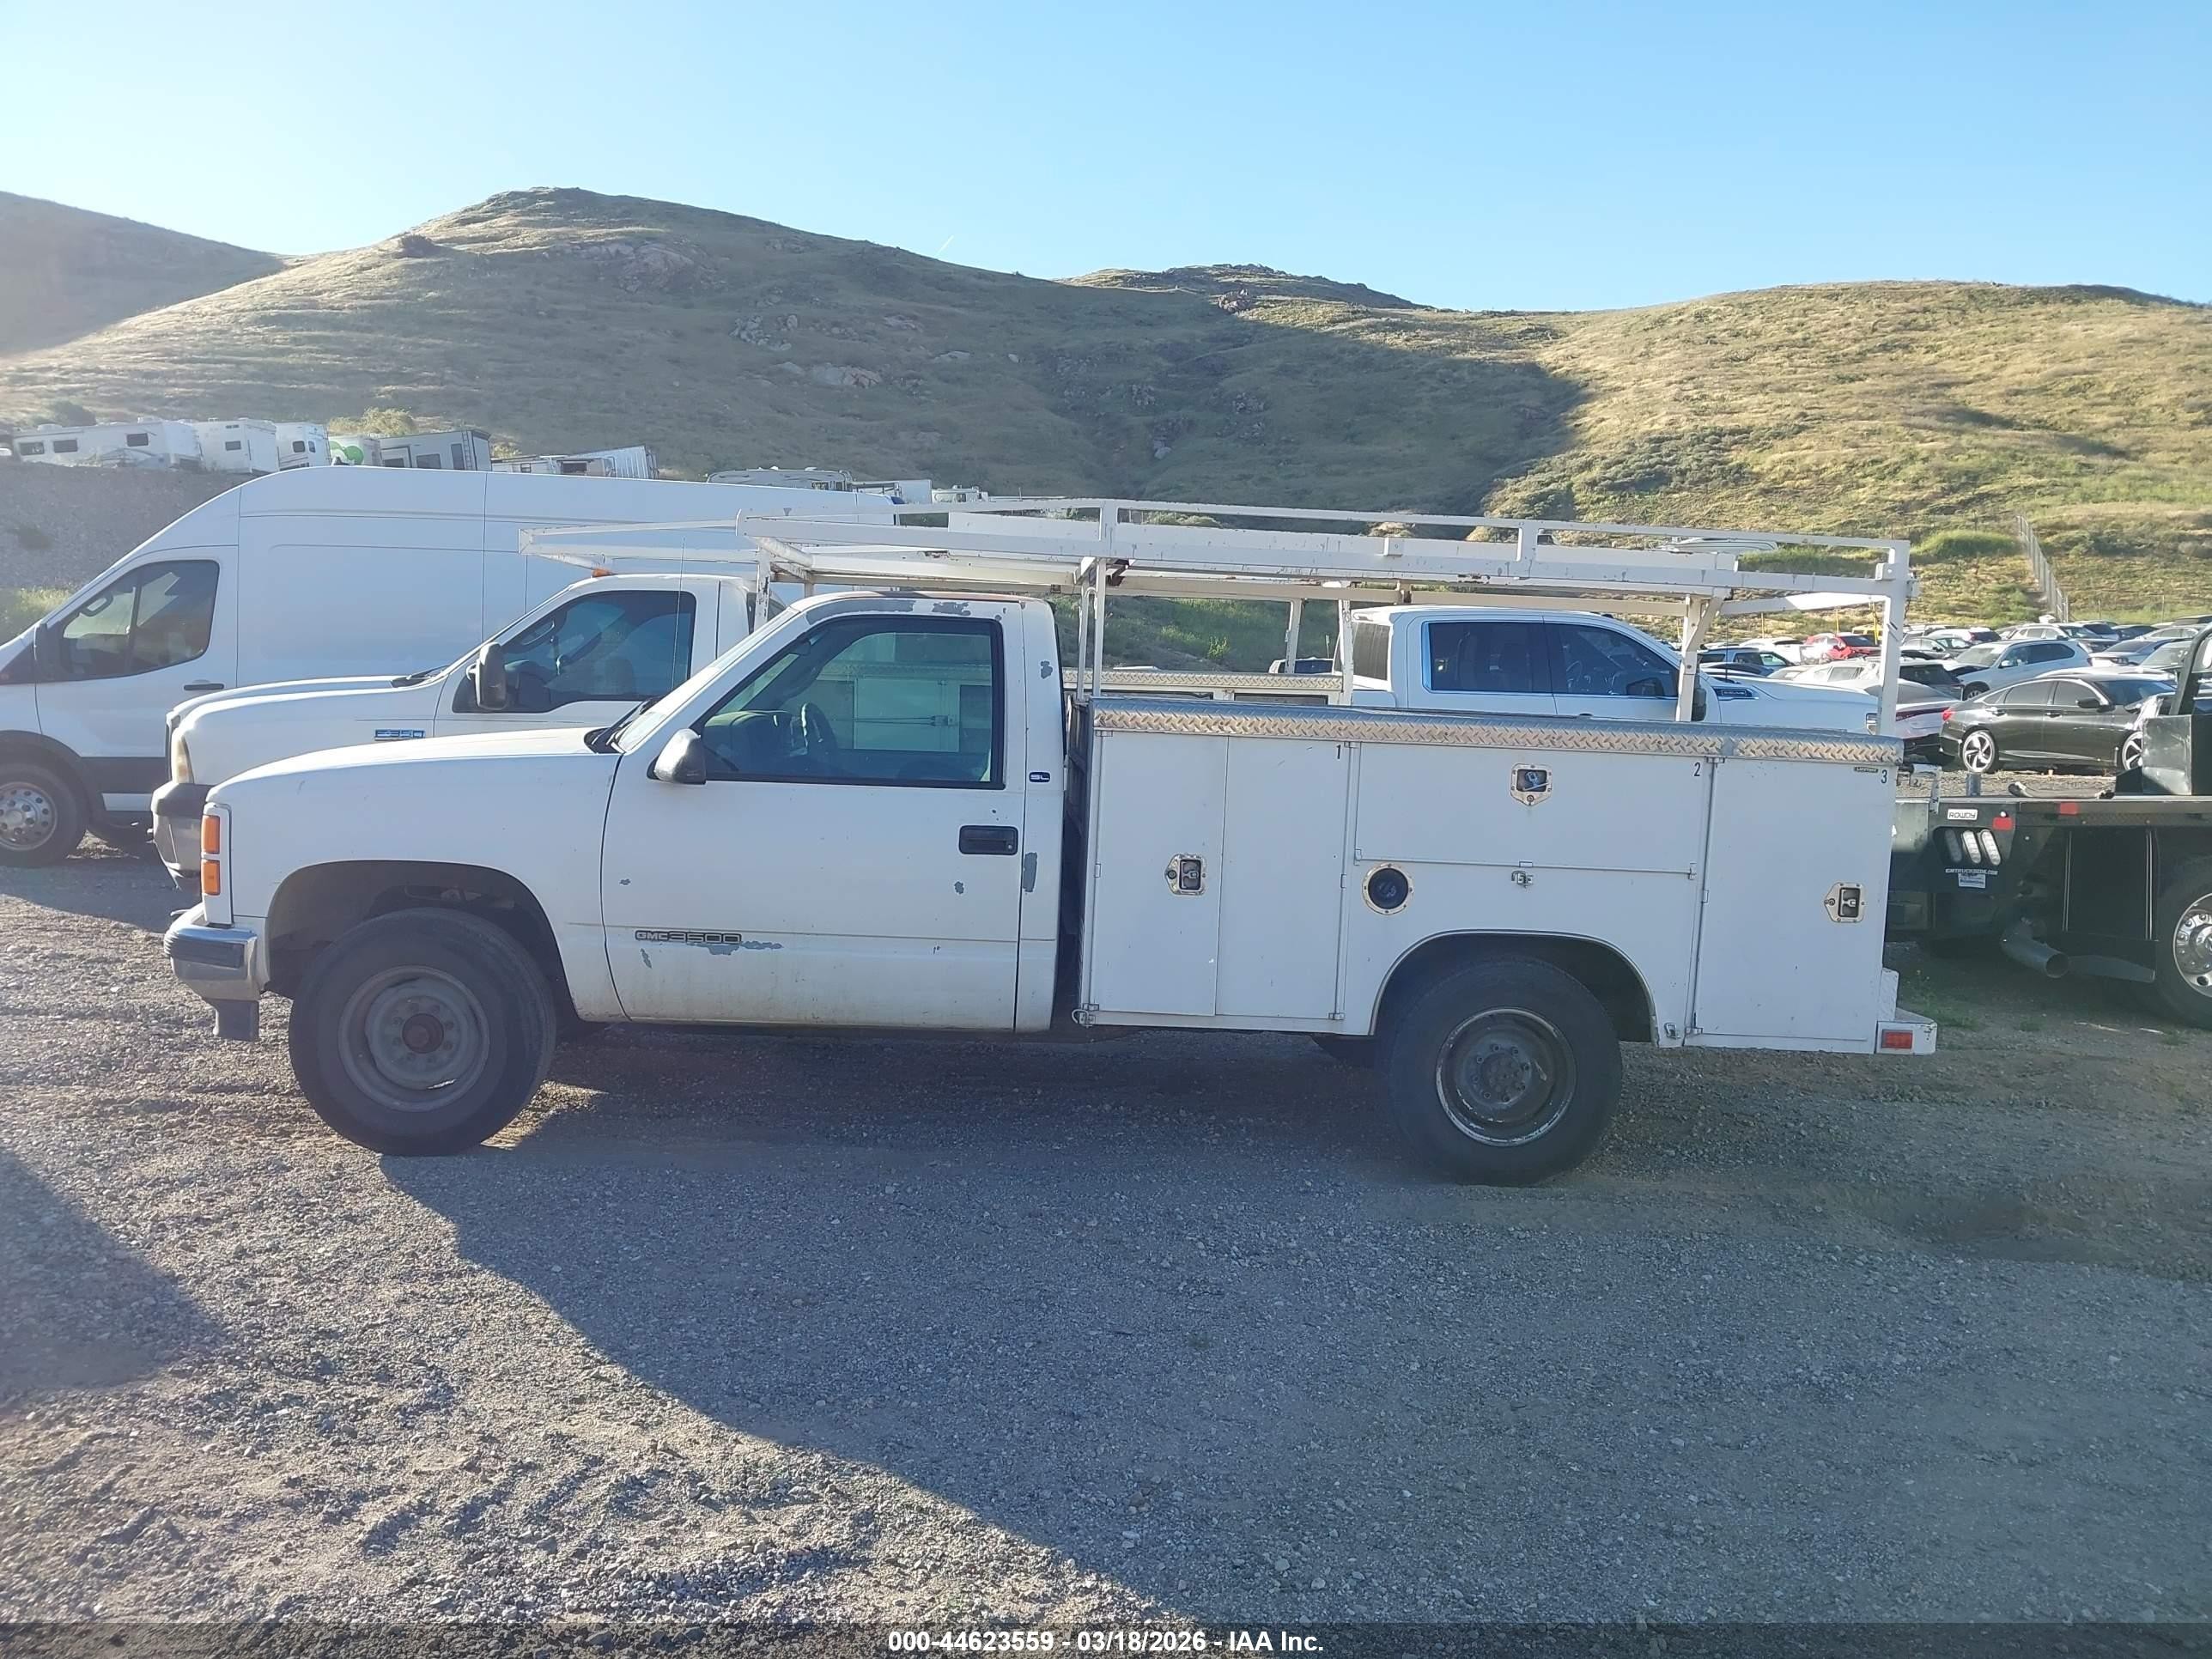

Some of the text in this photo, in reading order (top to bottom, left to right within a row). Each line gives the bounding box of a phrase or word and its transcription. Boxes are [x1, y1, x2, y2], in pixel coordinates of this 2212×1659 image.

[1336, 744, 1341, 759] 1
[1693, 762, 1701, 777] 2
[1881, 769, 1888, 784] 3
[635, 931, 741, 944] GMC 3500
